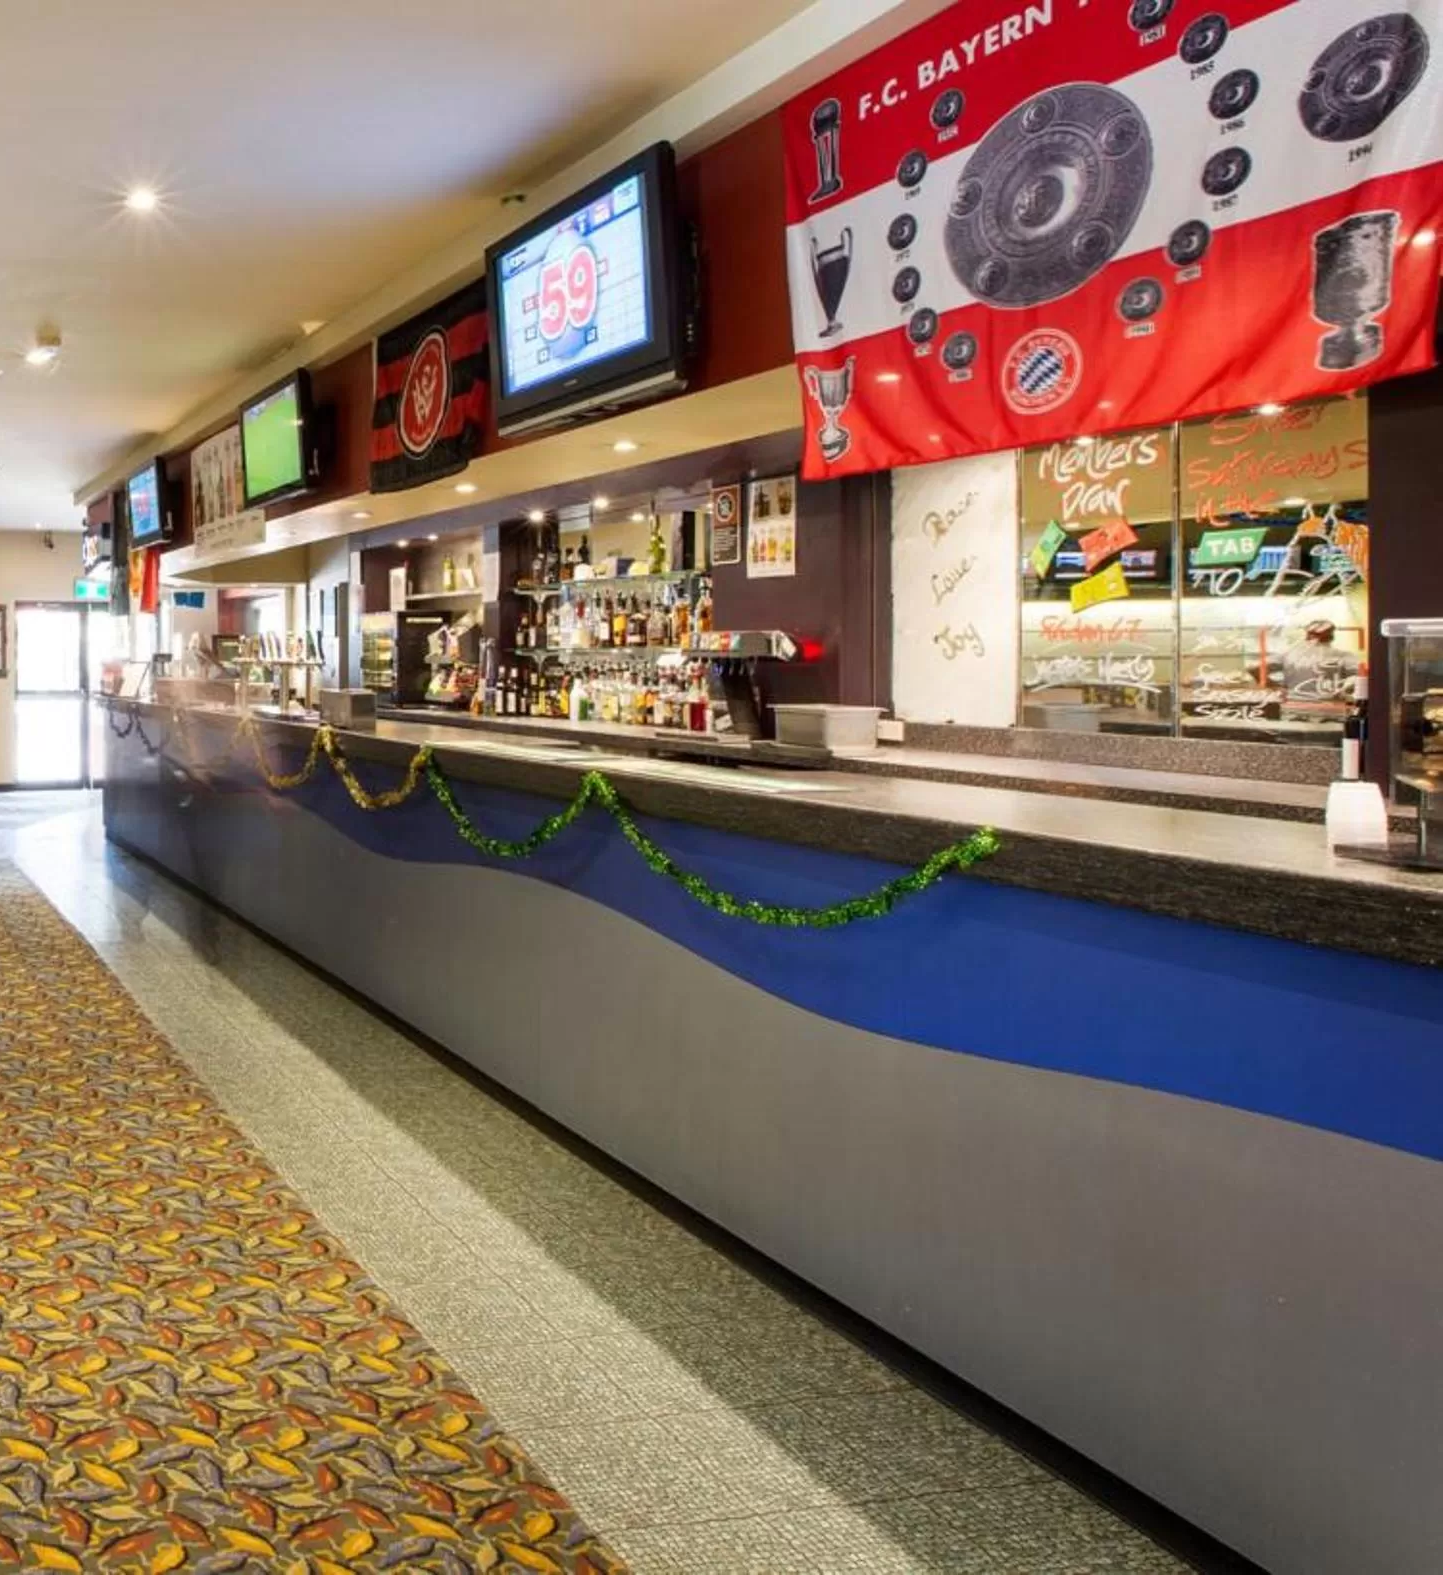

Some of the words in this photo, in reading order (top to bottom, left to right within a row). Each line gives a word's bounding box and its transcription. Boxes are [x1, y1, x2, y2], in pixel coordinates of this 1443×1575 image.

[858, 77, 908, 121] F.C.
[916, 0, 1053, 90] BAYERN
[539, 244, 598, 340] 59
[1039, 434, 1160, 482] Members
[1062, 478, 1131, 521] Draw
[1207, 536, 1255, 556] TAB
[933, 622, 985, 661] Joy
